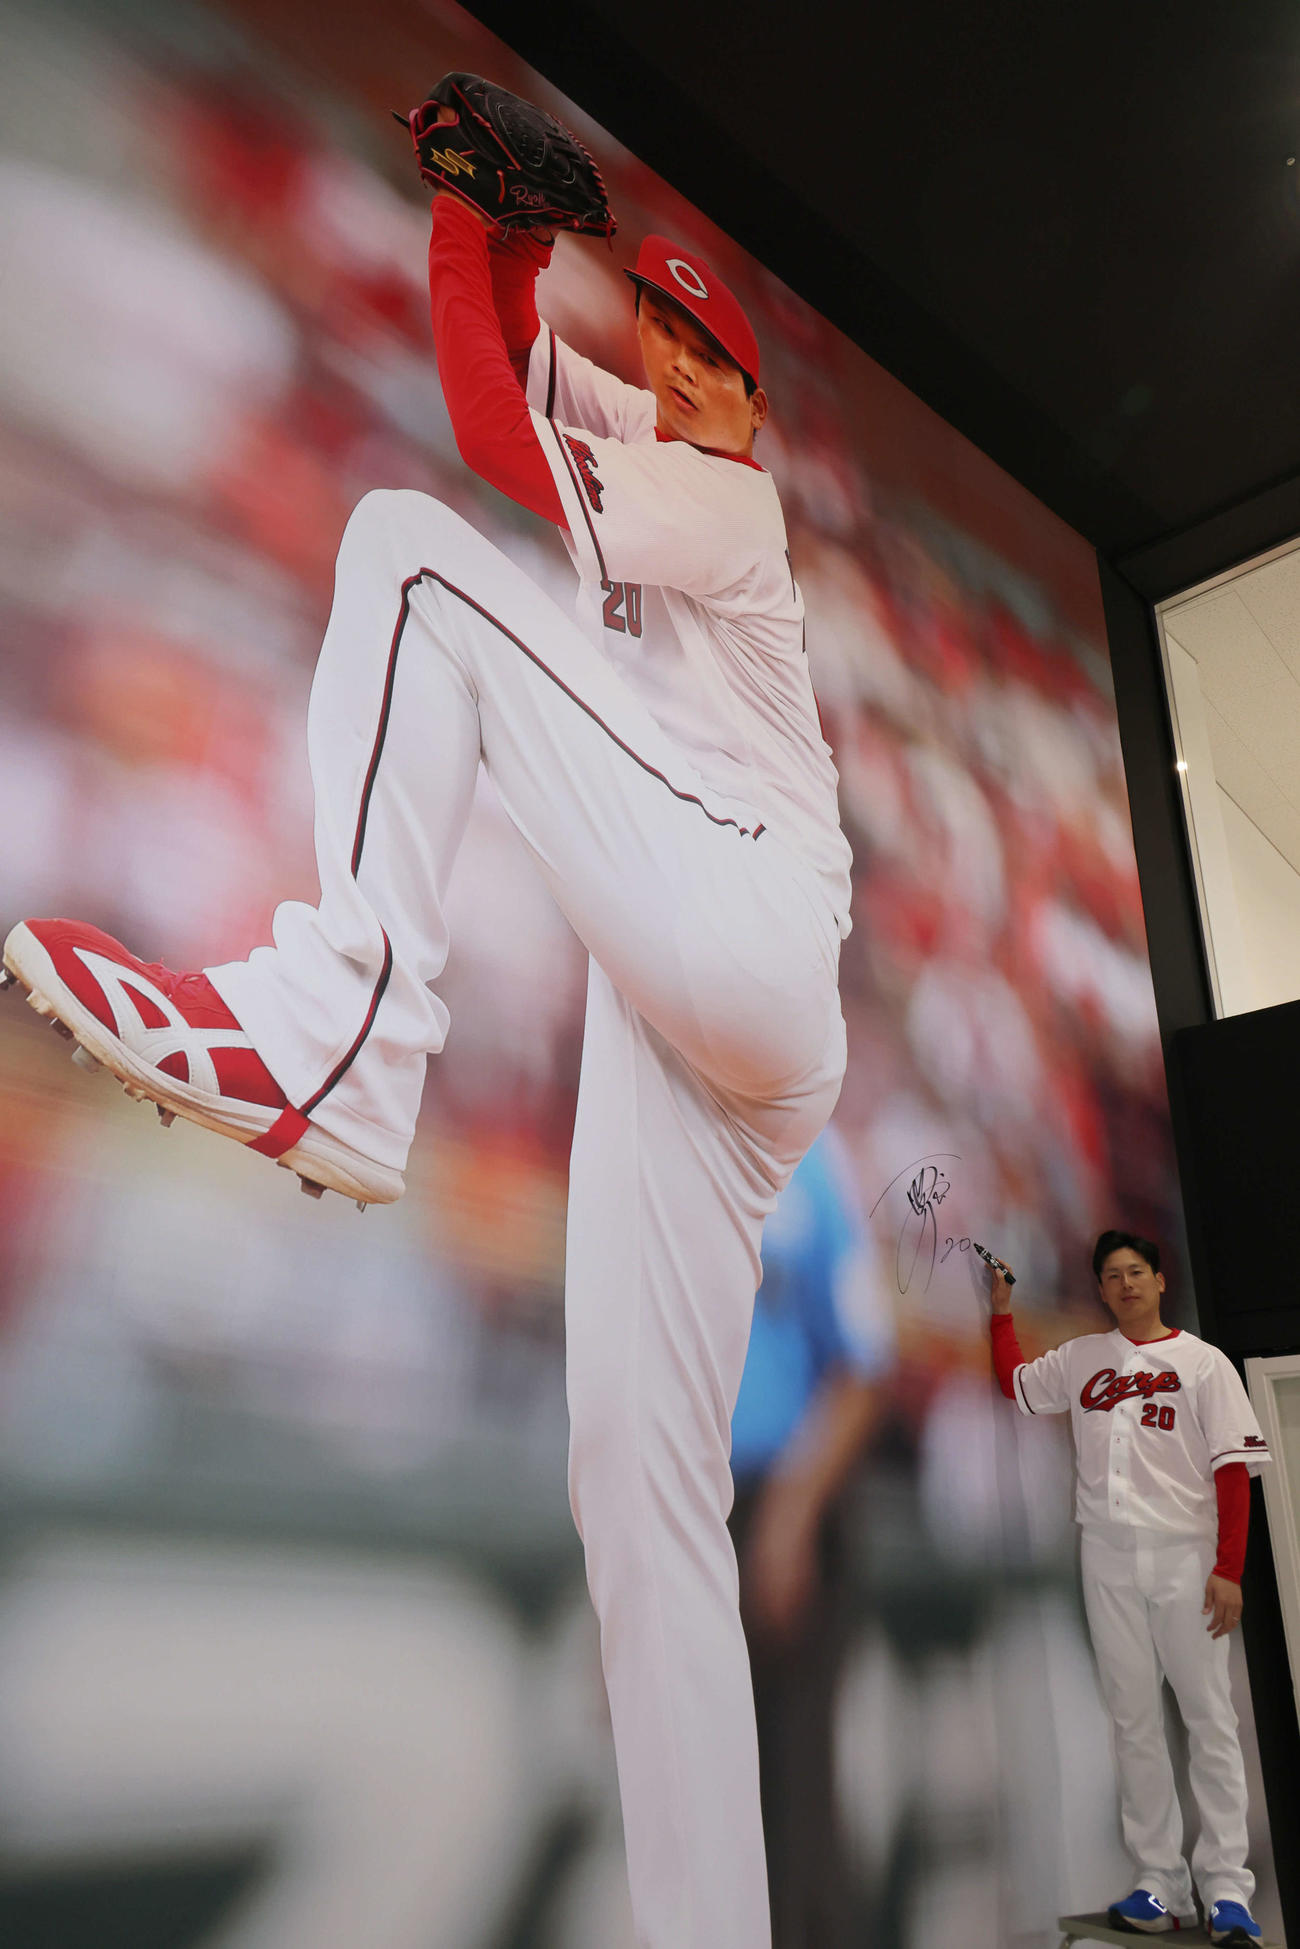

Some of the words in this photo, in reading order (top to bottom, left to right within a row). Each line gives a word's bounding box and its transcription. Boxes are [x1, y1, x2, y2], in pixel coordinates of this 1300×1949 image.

[664, 258, 709, 300] C
[600, 580, 643, 638] 20
[941, 1237, 971, 1264] 20
[1080, 1368, 1181, 1413] Carp
[1141, 1402, 1176, 1431] 20
